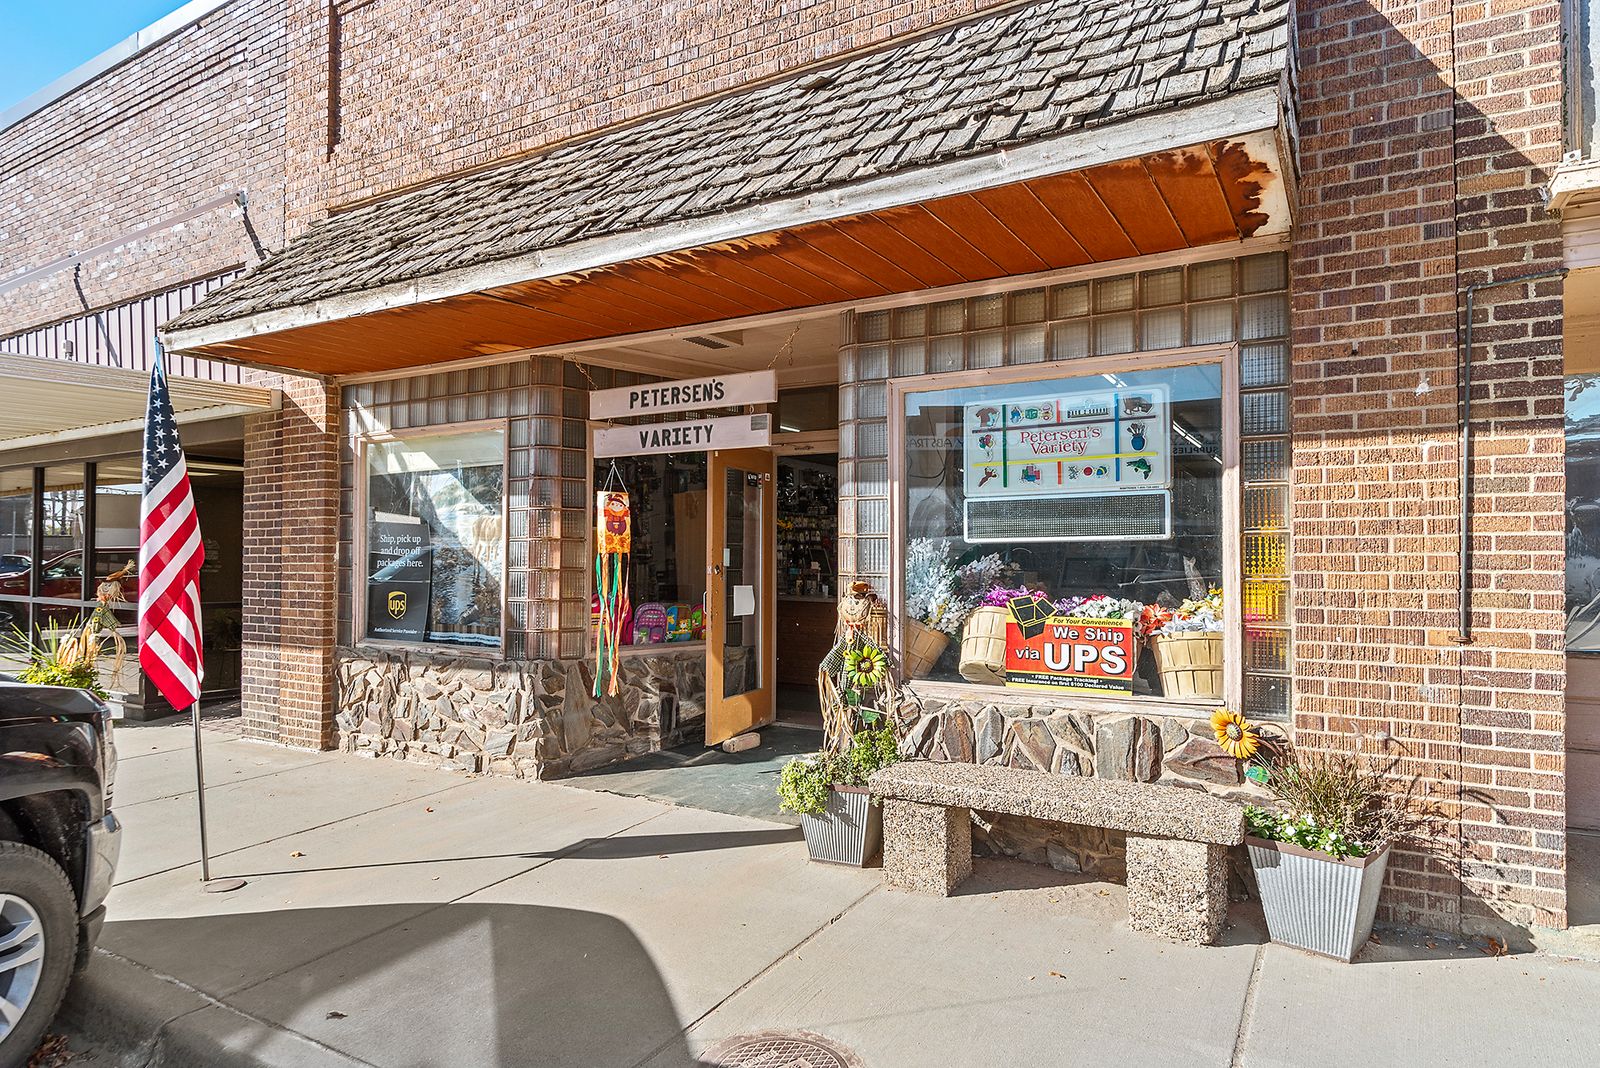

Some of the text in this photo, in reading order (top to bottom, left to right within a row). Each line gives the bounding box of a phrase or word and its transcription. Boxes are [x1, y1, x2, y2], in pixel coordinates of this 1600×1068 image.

[629, 378, 725, 409] PETERSEN'S
[639, 424, 713, 448] VARIETY
[1020, 426, 1101, 443] Petersen's
[1031, 440, 1087, 455] Variety
[380, 534, 422, 545] Ship, pick up
[380, 546, 422, 557] and drop off
[376, 558, 424, 569] packages here.
[1081, 618, 1124, 626] Convenience
[1052, 625, 1125, 645] We Ship
[1015, 642, 1127, 676] via UPS
